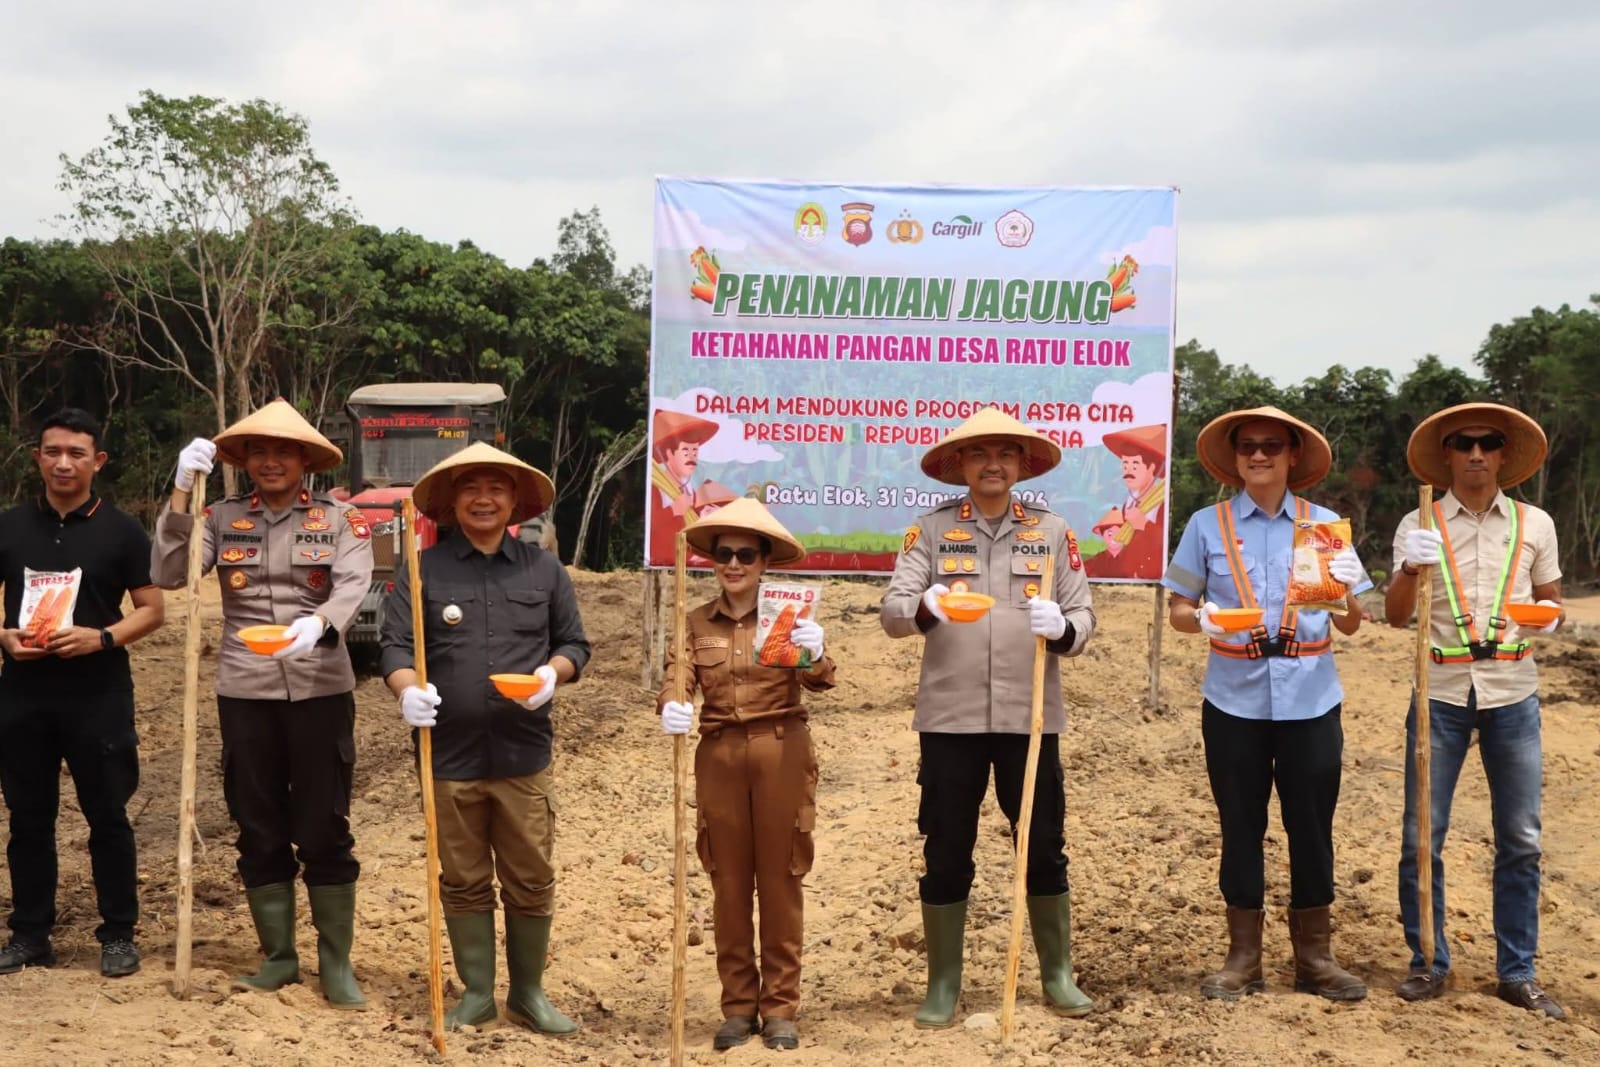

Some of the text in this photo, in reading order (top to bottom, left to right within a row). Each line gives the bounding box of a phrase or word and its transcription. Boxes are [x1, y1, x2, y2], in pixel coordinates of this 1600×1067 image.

[932, 219, 983, 239] Cargill
[712, 274, 1112, 324] PENANAMAN JAGUNG
[691, 332, 1131, 367] KETAHANAN PANGAN DESA RATU ELOK
[696, 395, 769, 415] DALAM
[776, 398, 908, 417] MENDUKUNG
[1027, 403, 1082, 421] ASTA
[1088, 404, 1134, 423] CITA
[744, 423, 955, 445] PRESIDEN REPUBL
[765, 485, 817, 505] Ratu
[822, 485, 873, 508] Elok,
[877, 487, 898, 507] 31
[296, 534, 333, 544] POLRI
[939, 544, 977, 554] M.HARRIS
[1012, 545, 1050, 555] POLRI
[764, 590, 814, 603] BETRAS 9
